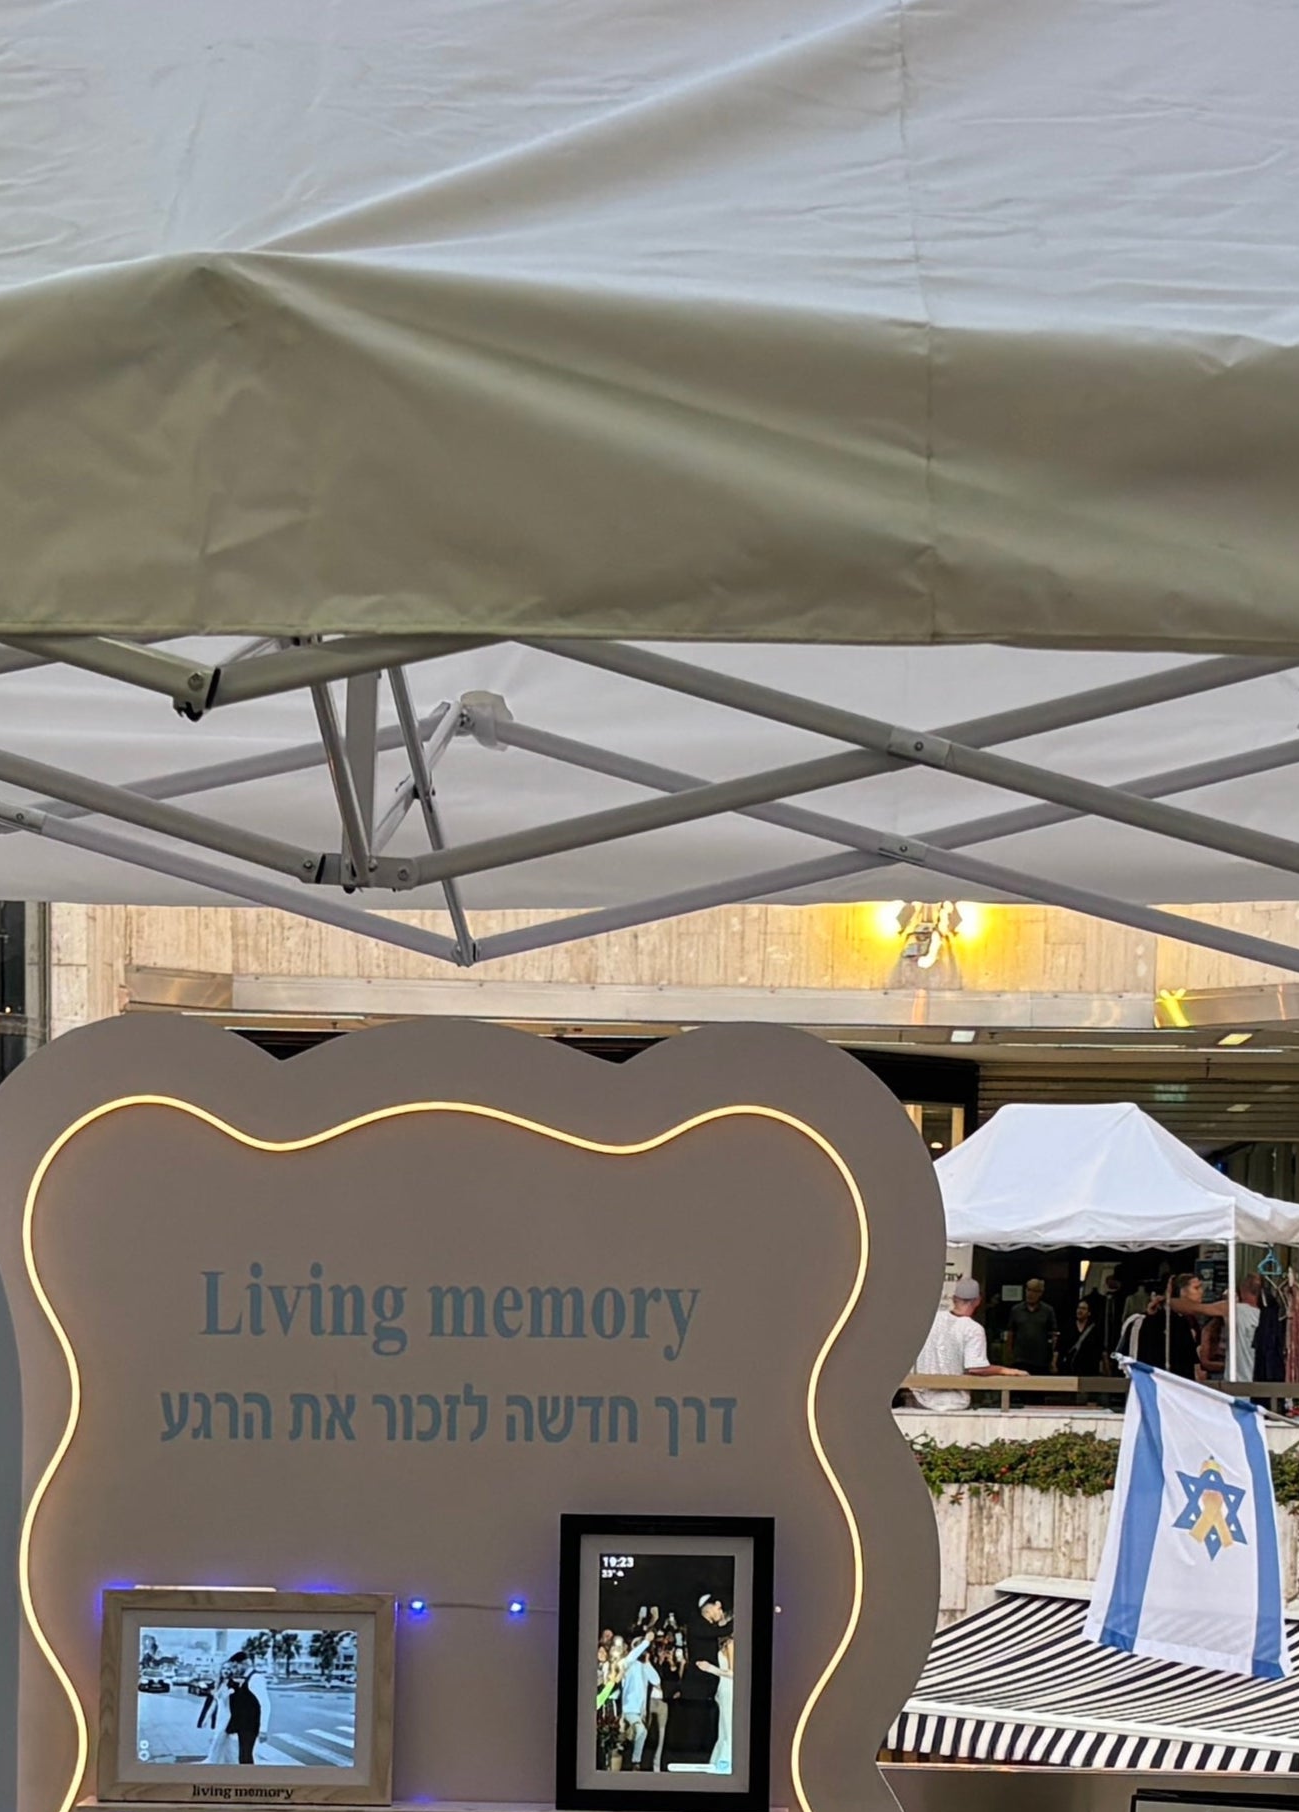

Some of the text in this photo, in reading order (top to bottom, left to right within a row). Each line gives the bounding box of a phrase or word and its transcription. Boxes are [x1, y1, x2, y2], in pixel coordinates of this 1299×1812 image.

[199, 1262, 701, 1361] Living memory
[160, 1383, 738, 1457] דרך חדשה לזכור את הרגע
[192, 1784, 294, 1800] living memory
